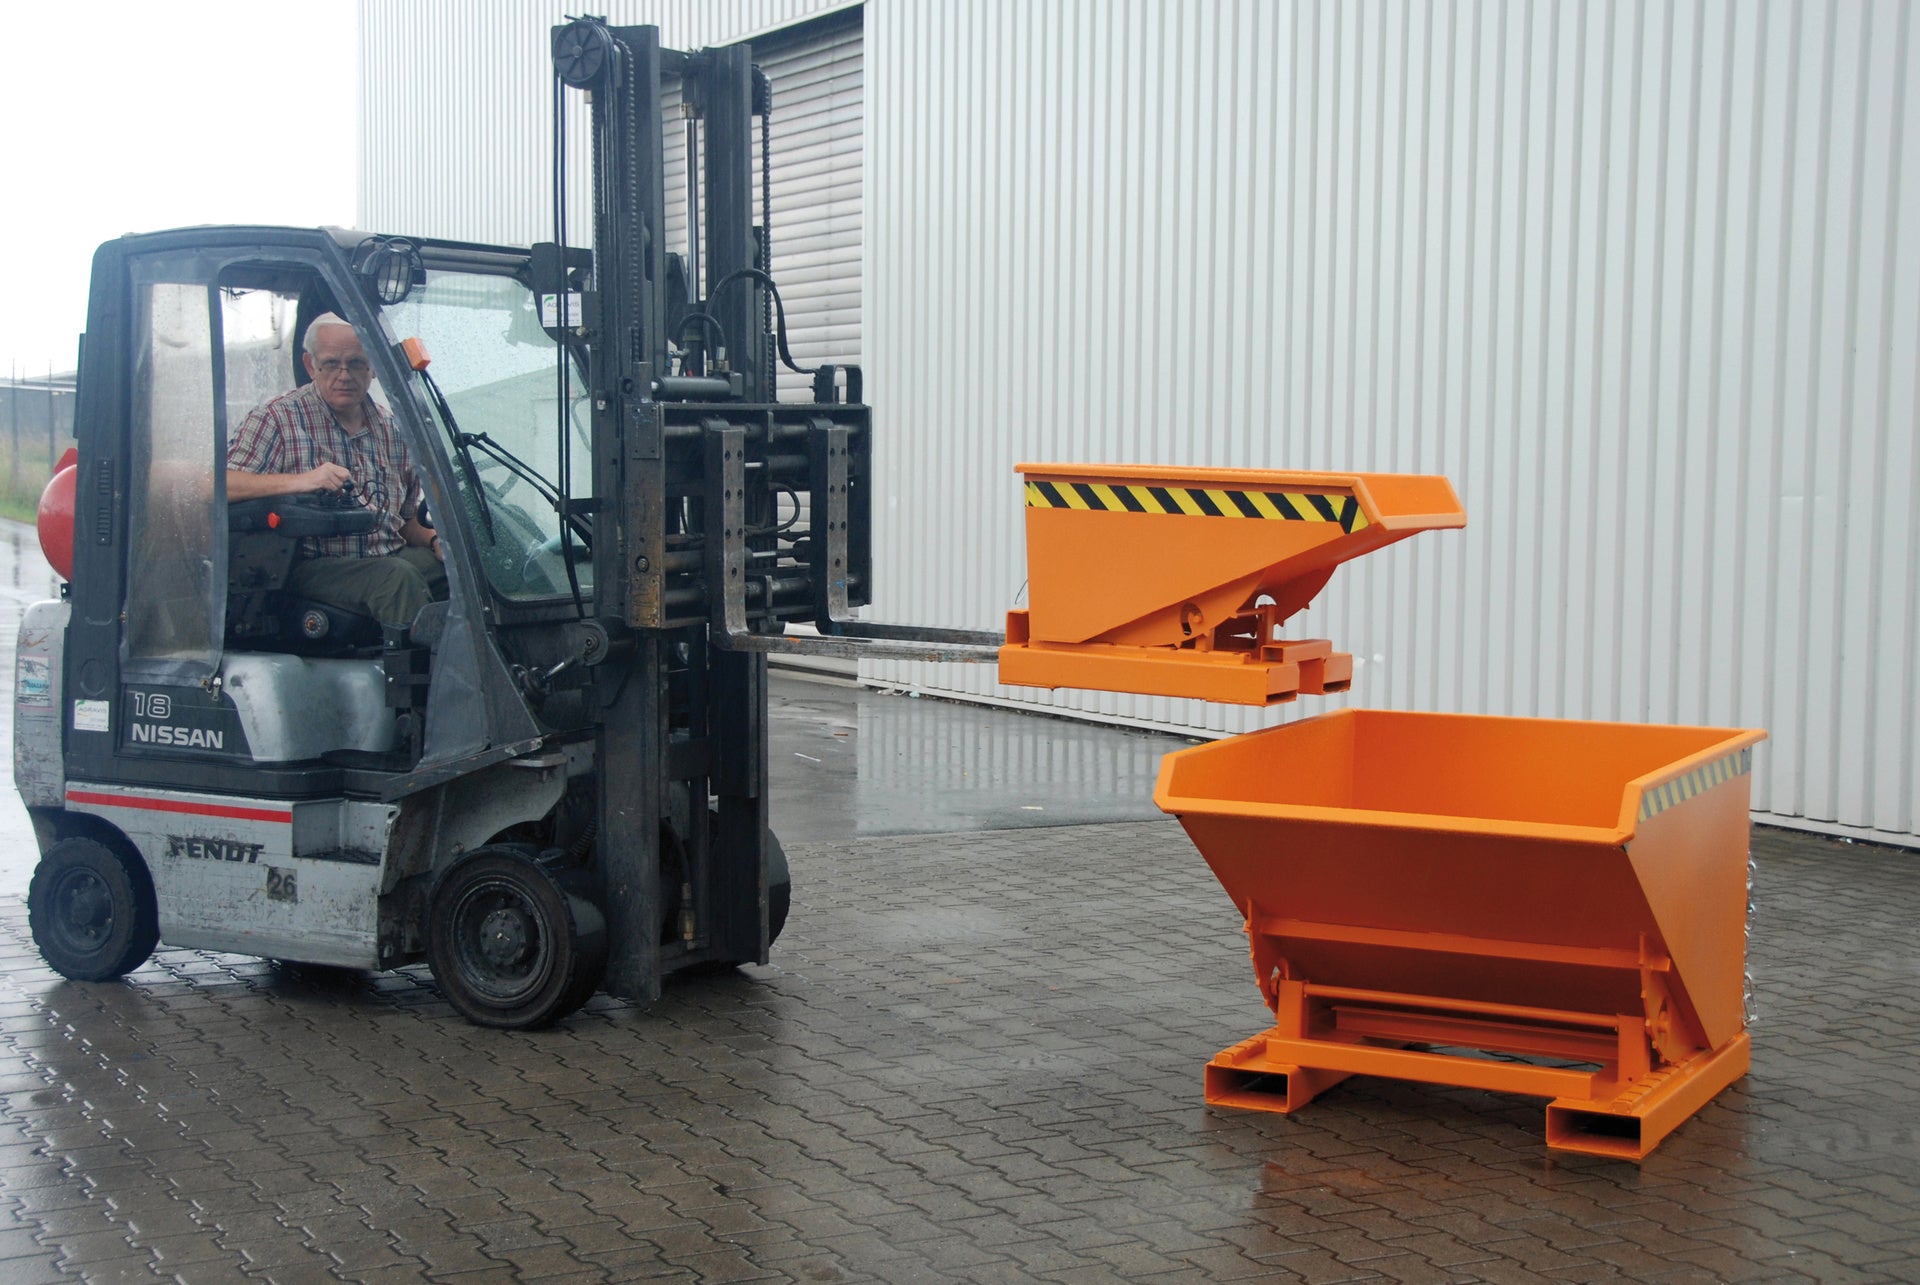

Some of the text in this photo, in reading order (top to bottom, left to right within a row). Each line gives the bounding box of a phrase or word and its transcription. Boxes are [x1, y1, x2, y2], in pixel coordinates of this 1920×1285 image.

[135, 692, 171, 719] 18
[132, 723, 223, 749] NISSAN
[168, 835, 264, 863] FENDT
[269, 874, 296, 897] 26
